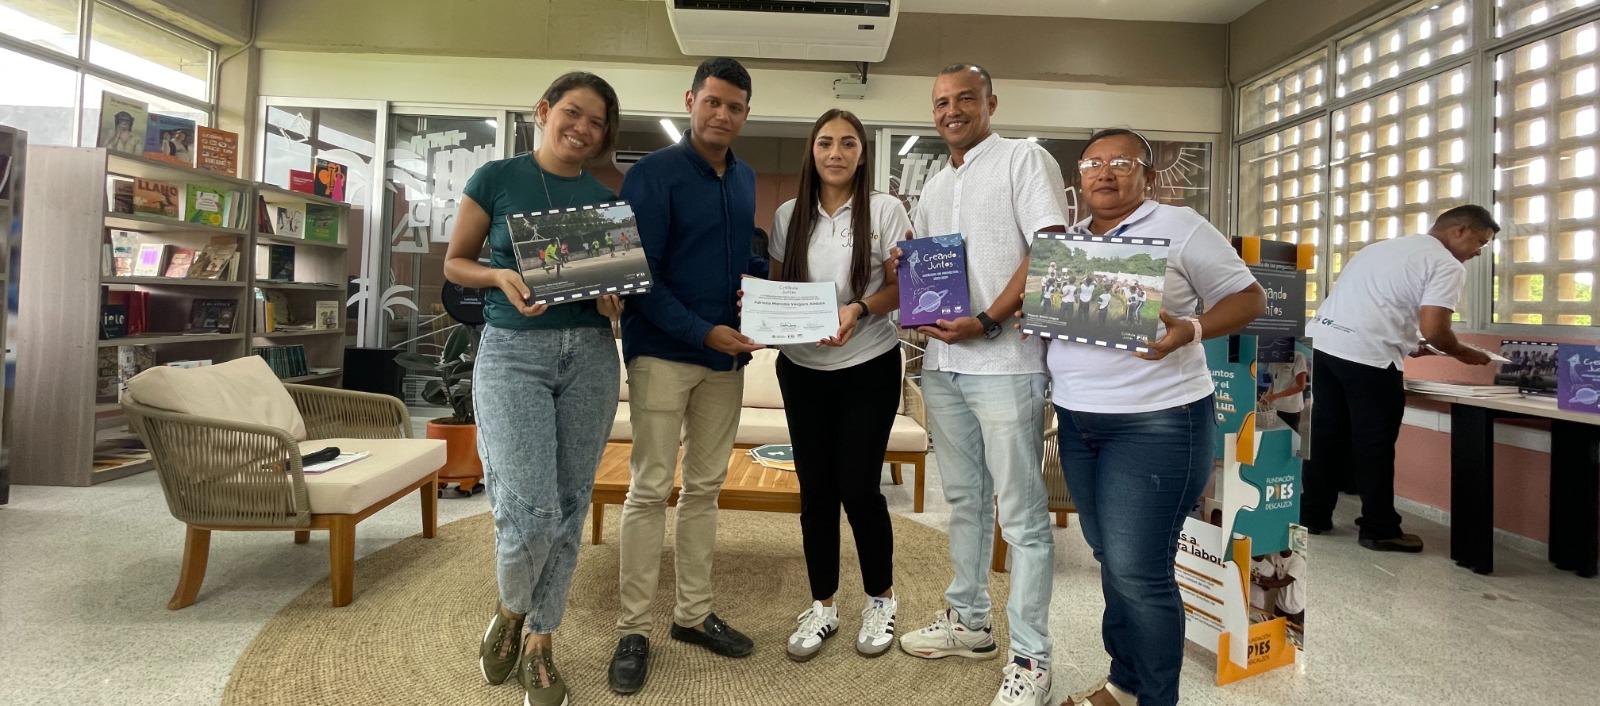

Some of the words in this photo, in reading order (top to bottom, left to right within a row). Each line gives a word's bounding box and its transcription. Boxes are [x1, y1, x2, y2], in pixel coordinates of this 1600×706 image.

[923, 250, 957, 262] Creando
[927, 260, 954, 270] Juntos
[1211, 370, 1235, 379] untos
[1265, 483, 1294, 502] PIES
